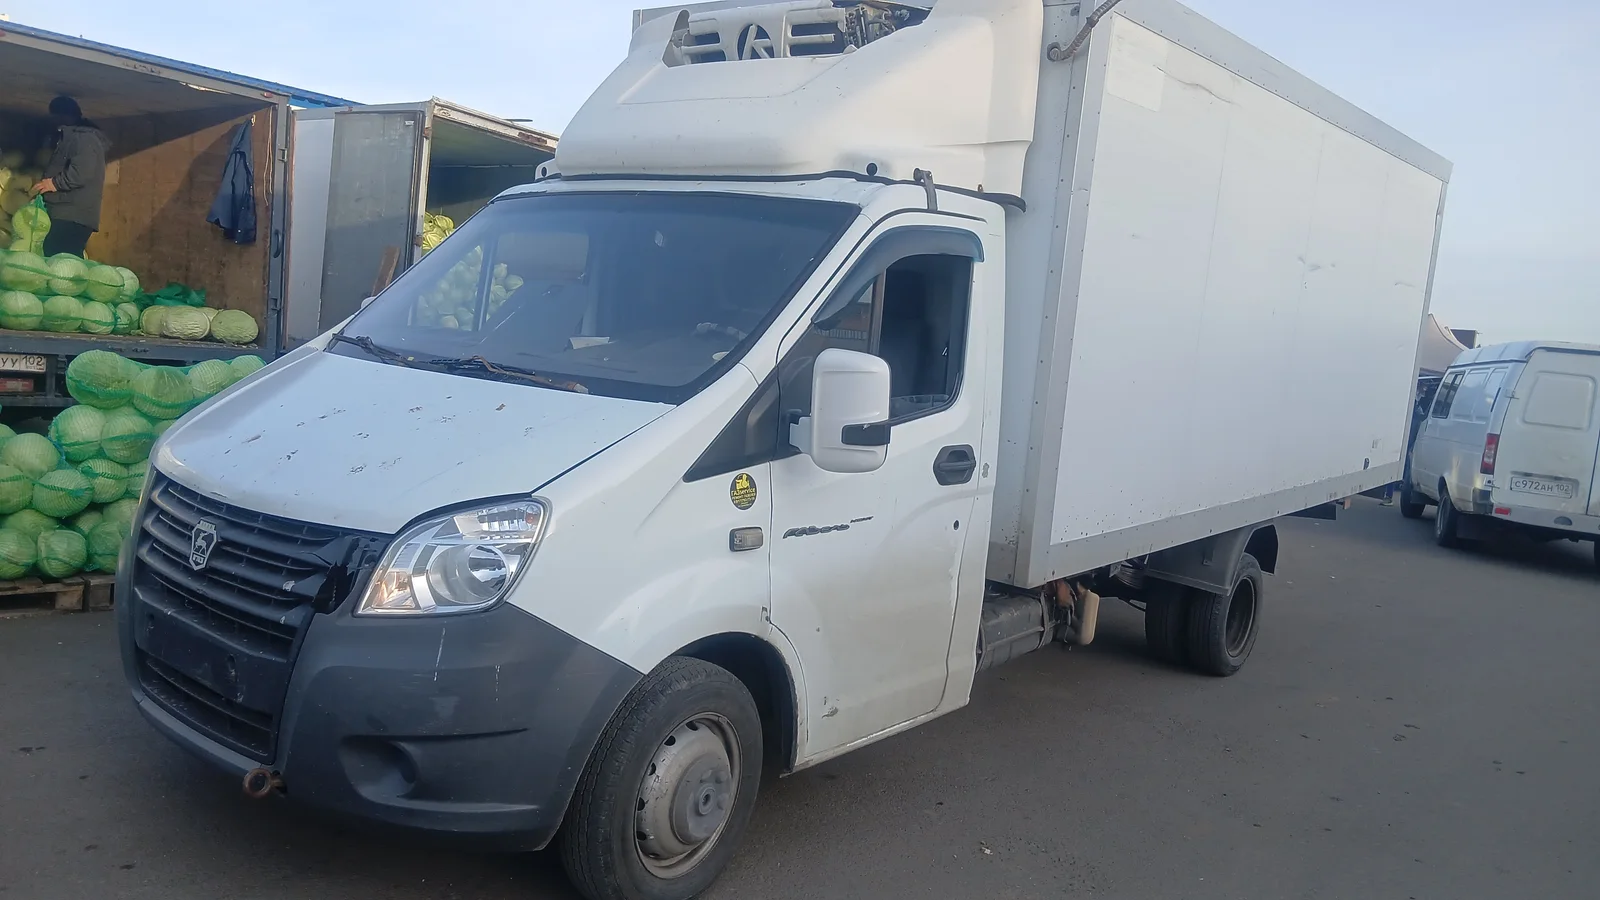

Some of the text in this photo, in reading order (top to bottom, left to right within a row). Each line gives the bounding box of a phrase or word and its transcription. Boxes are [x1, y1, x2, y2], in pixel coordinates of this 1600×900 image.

[22, 355, 45, 367] 102
[1515, 480, 1571, 492] С972АН 102
